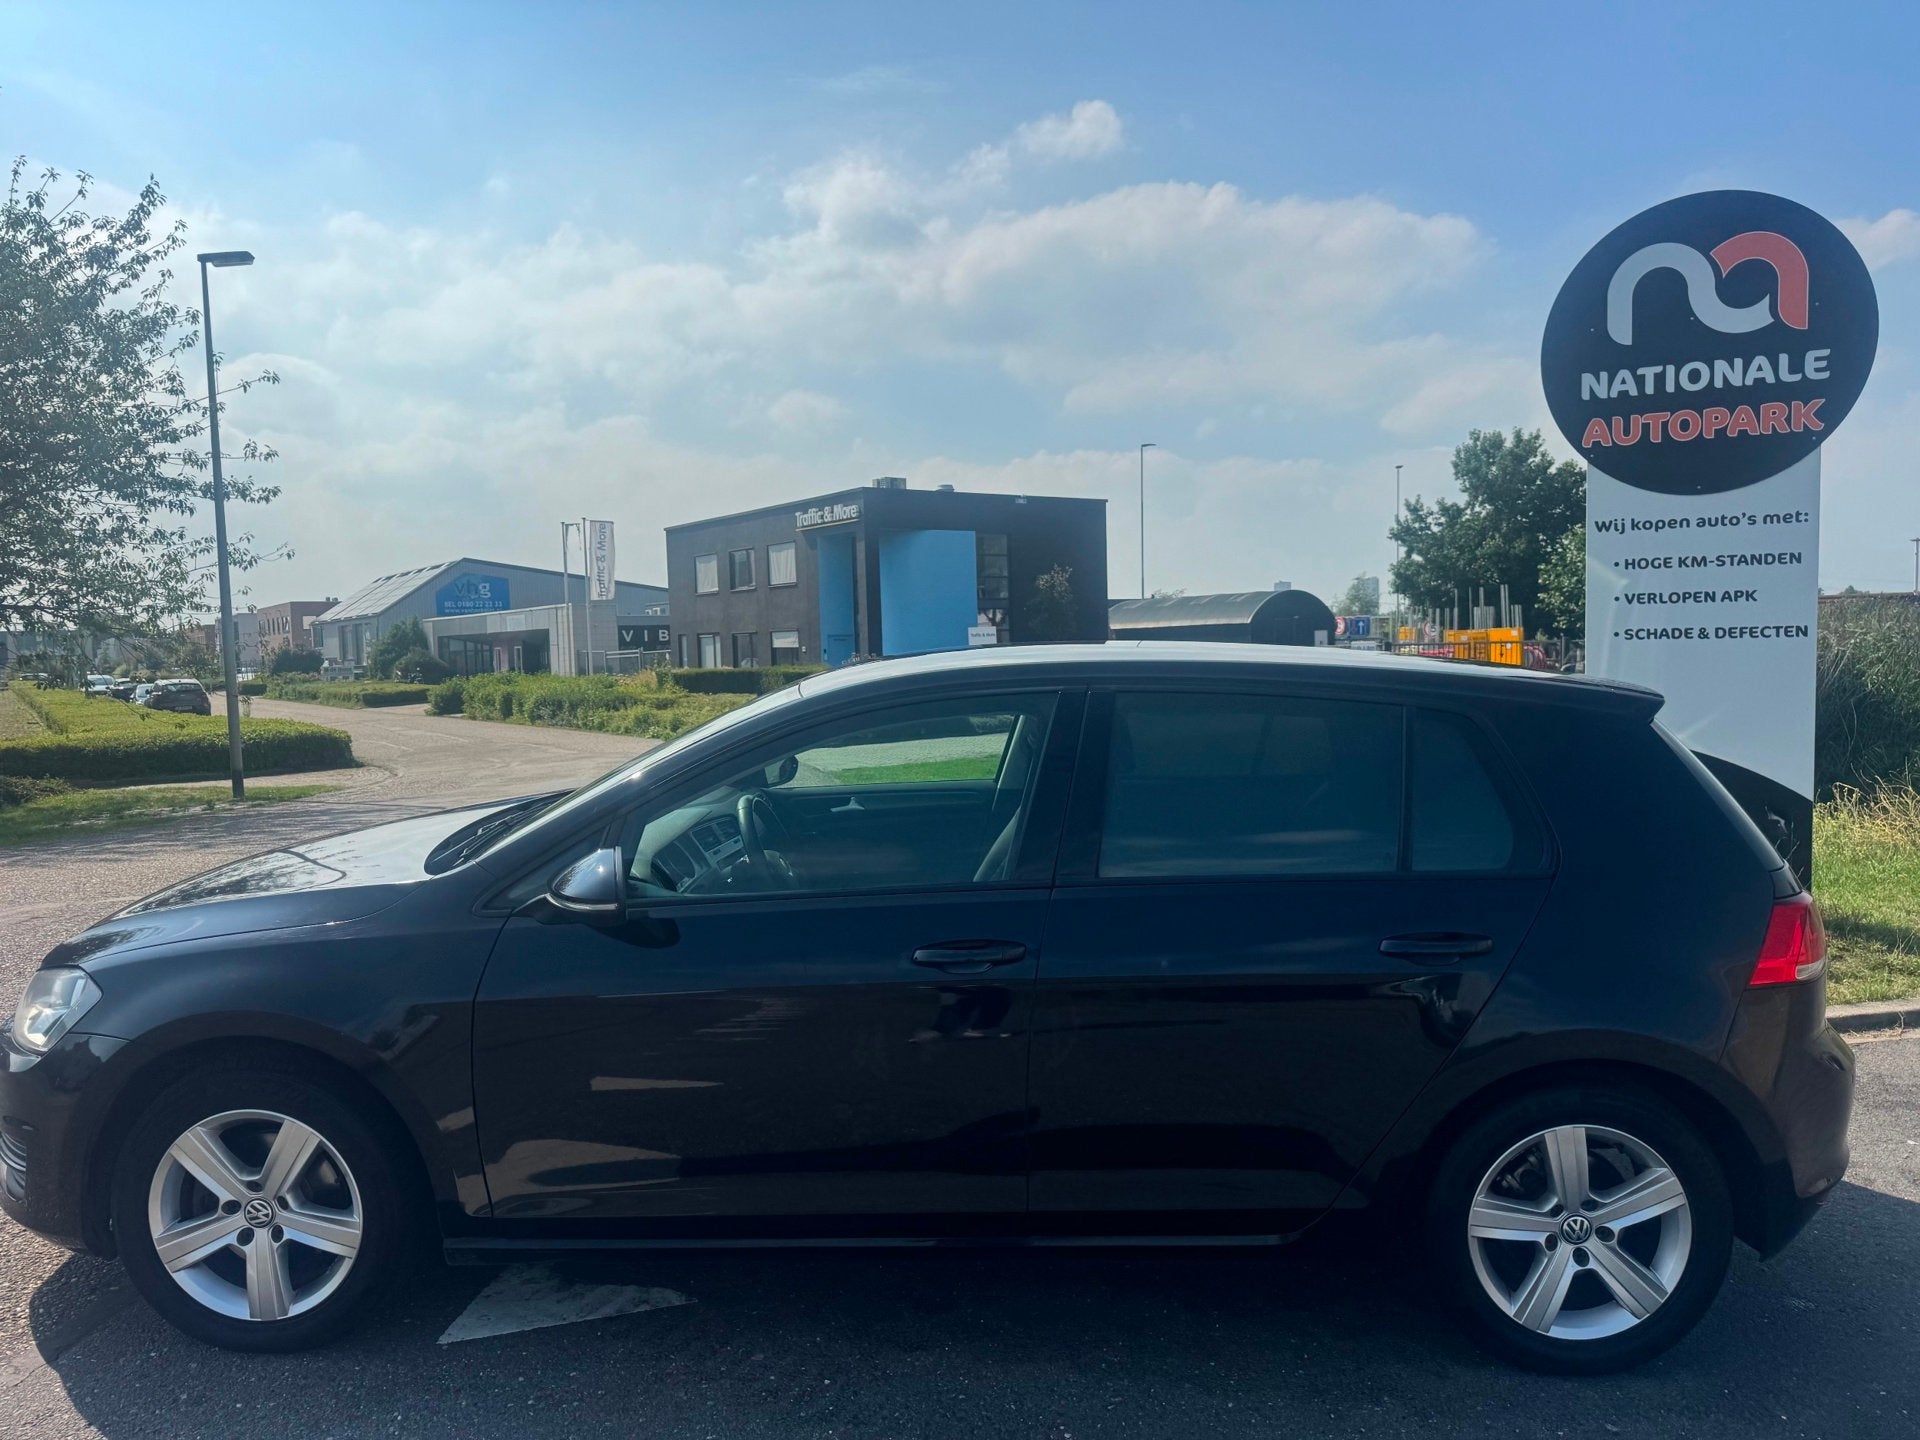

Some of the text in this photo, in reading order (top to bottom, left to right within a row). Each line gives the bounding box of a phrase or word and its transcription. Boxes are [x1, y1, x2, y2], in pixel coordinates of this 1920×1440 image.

[1581, 348, 1831, 400] NATIONALE
[1582, 398, 1826, 448] AUTOPARK
[795, 504, 859, 527] Traffic & More
[1594, 511, 1809, 534] Wij kopen auto's met:
[597, 523, 607, 551] More
[1624, 552, 1802, 570] HOGE KM-STANDEN
[1624, 589, 1758, 605] VERLOPEN APK
[1624, 625, 1809, 641] SCHADE & DEFECTEN
